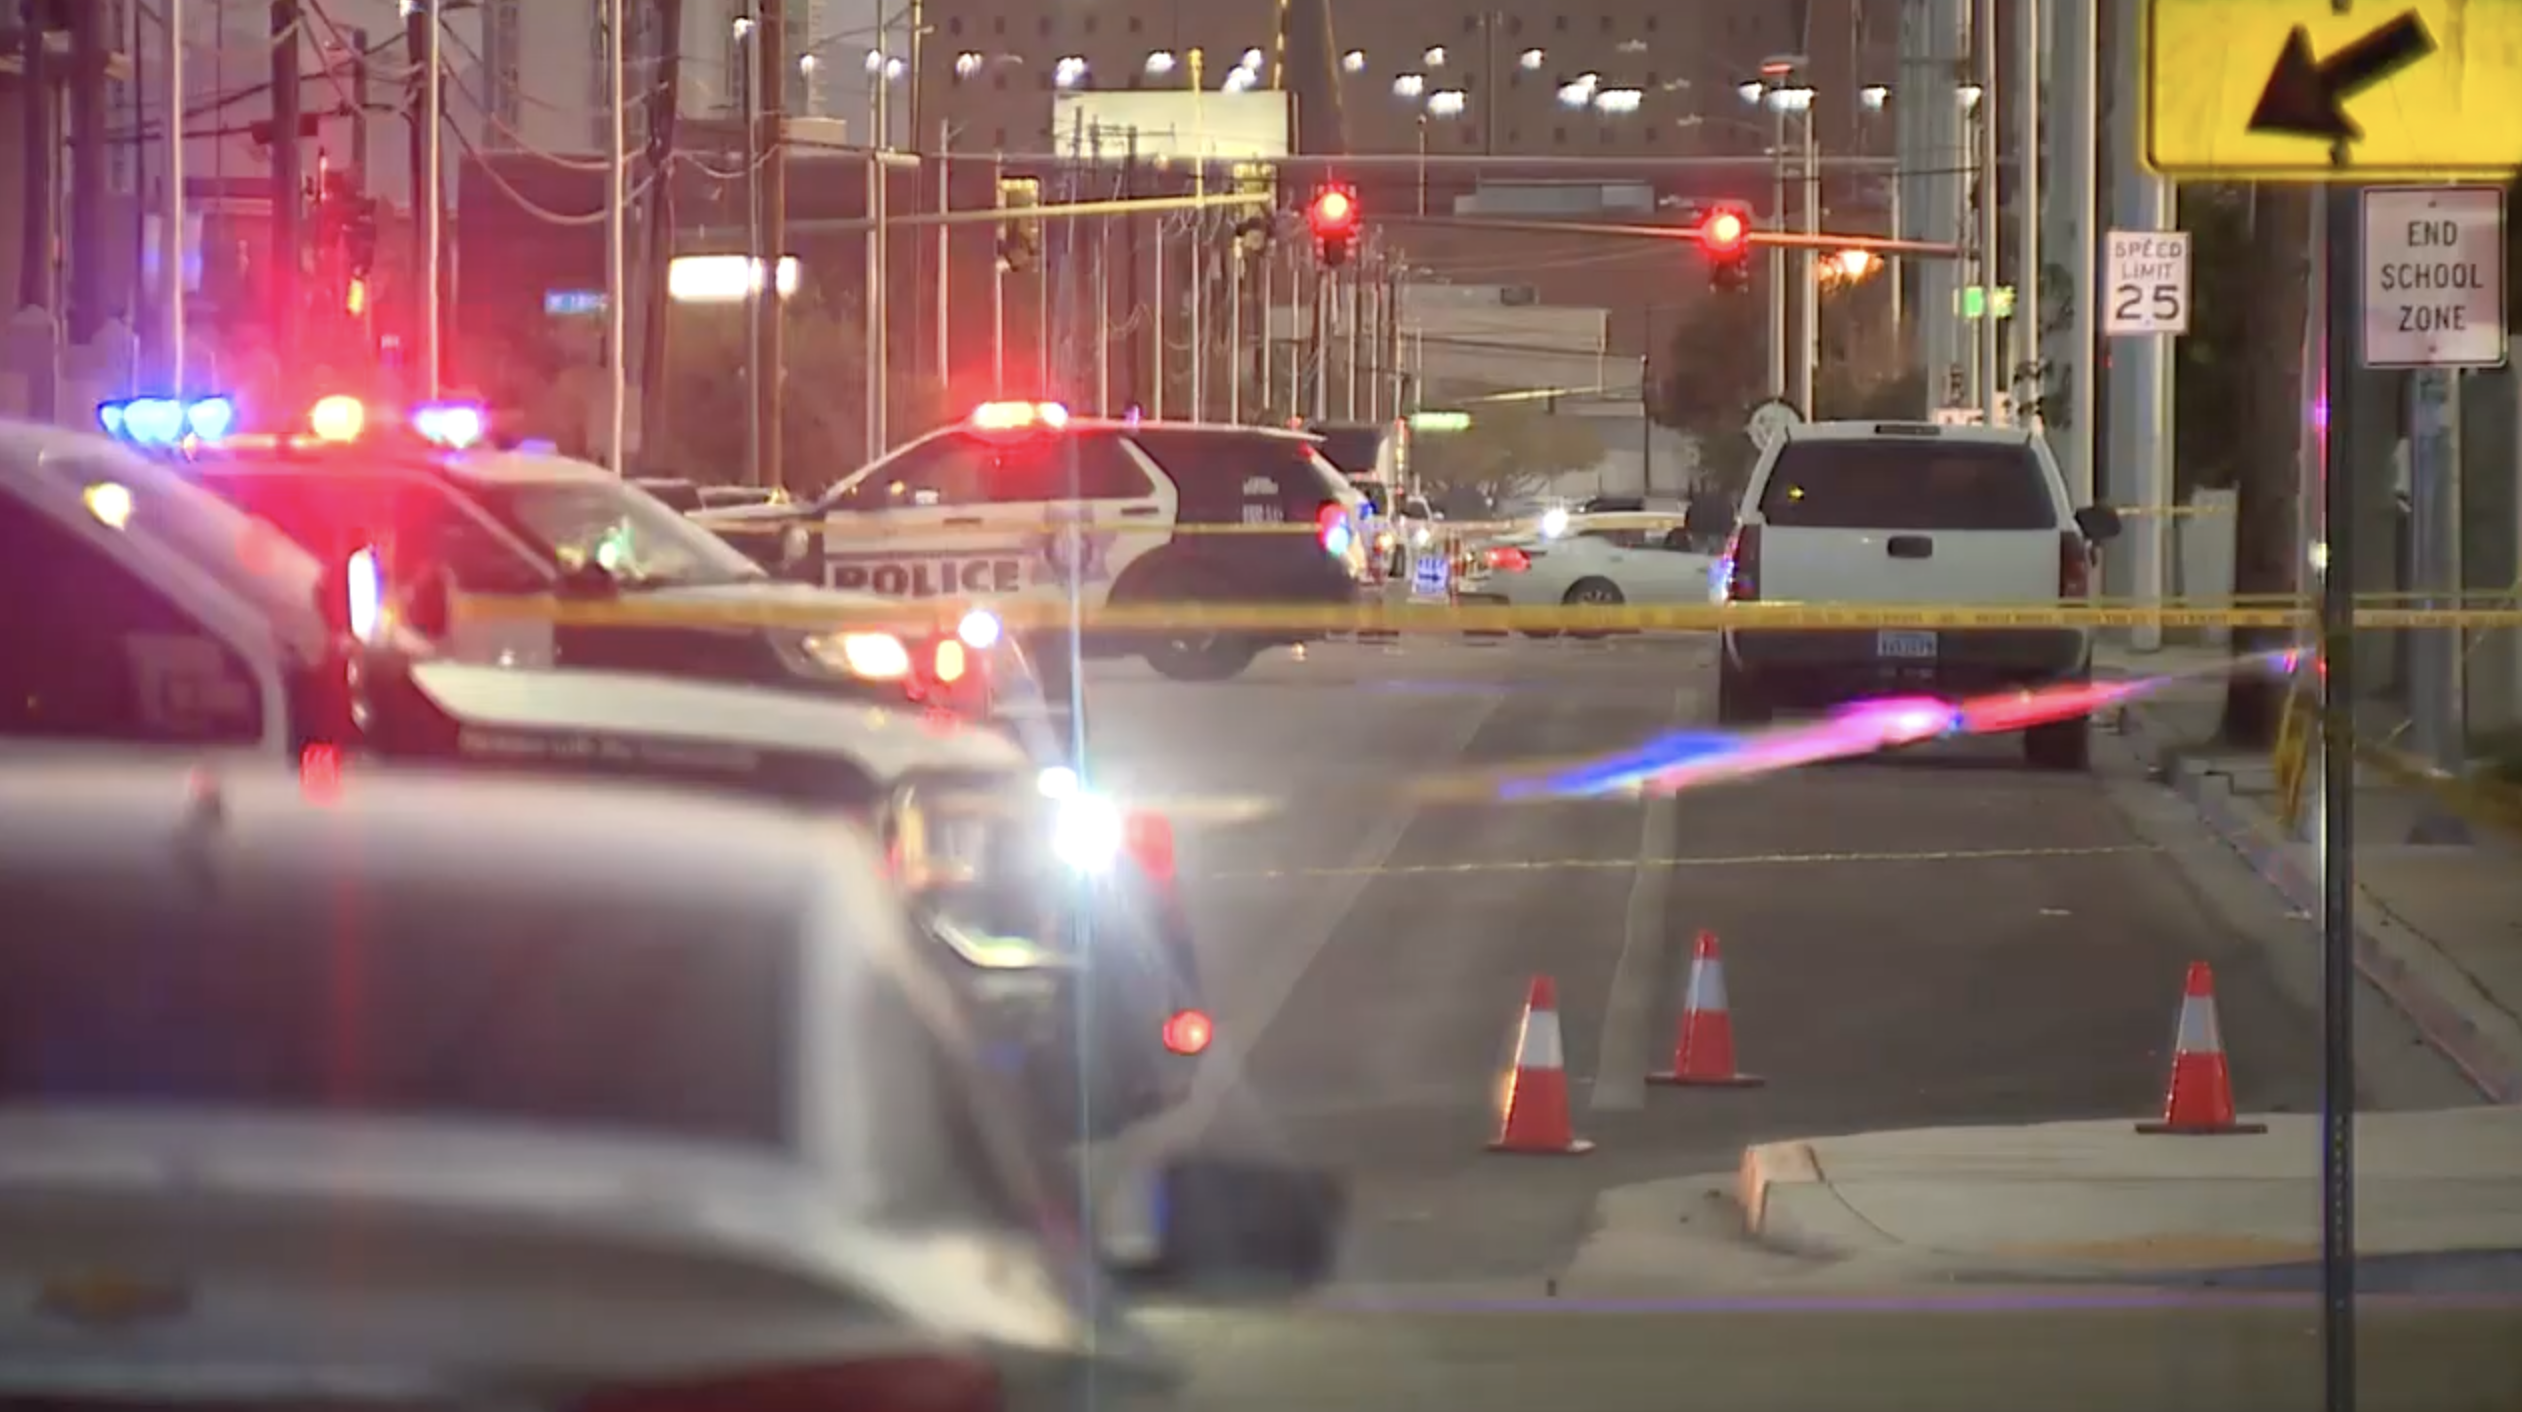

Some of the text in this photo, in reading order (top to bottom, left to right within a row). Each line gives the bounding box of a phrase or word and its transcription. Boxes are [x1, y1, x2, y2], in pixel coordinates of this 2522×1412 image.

[2408, 220, 2457, 247] END
[2115, 241, 2182, 258] SPEED
[2122, 262, 2173, 280] LIMIT
[2380, 263, 2484, 291] SCHOOL
[2116, 284, 2179, 320] 25
[2398, 305, 2466, 332] ZONE
[834, 560, 1020, 597] POLICE
